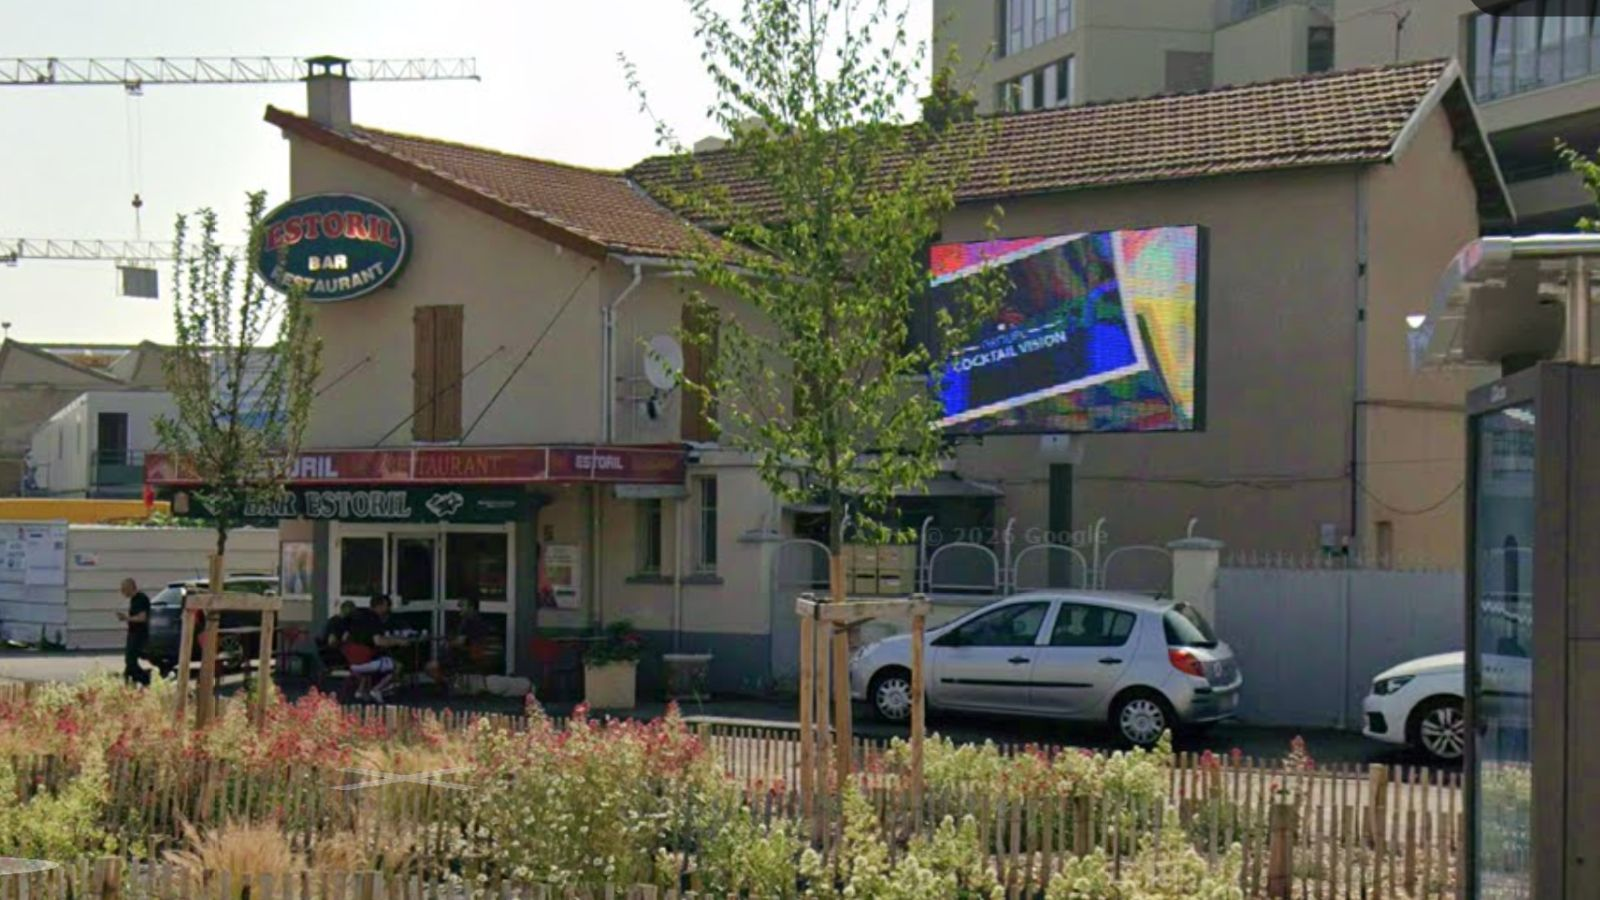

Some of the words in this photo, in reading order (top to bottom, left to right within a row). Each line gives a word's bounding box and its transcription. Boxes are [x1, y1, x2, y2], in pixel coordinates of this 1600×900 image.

[266, 211, 398, 250] ESTORIL
[308, 254, 348, 271] BAR
[953, 345, 1018, 372] COCKTAIL
[1018, 330, 1067, 353] VISION
[575, 455, 623, 470] ESTORIL
[304, 490, 411, 517] ESTORIL
